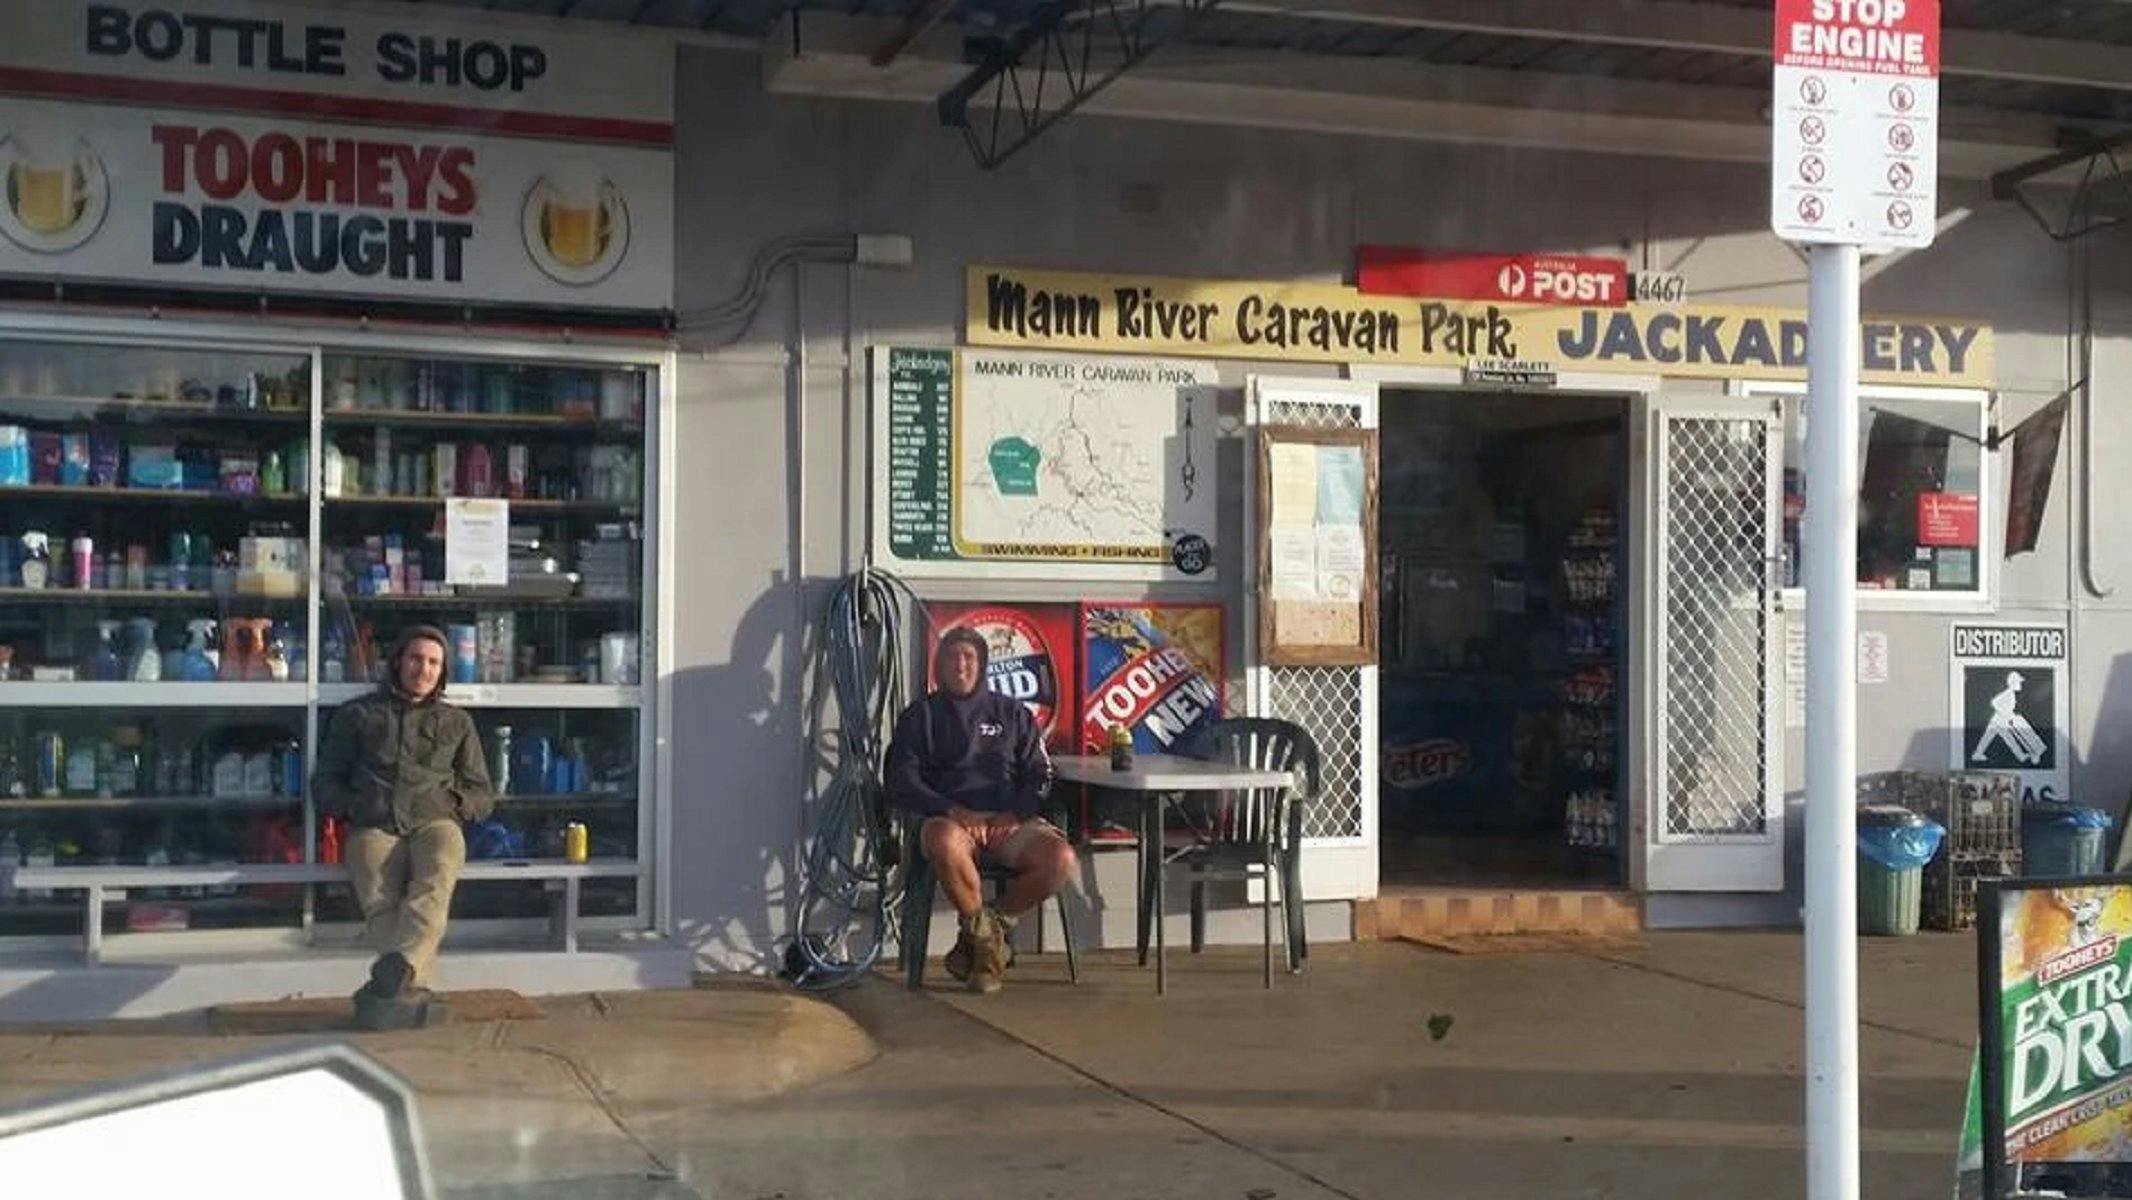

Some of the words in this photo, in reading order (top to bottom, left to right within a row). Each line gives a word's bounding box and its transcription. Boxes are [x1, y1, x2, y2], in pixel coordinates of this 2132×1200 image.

[1812, 0, 1906, 27] STOP
[86, 5, 346, 76] BOTTLE
[376, 32, 547, 91] SHOP
[1791, 22, 1925, 64] ENGINE
[152, 125, 479, 215] TOOHEYS
[152, 202, 473, 282] DRAUGHT
[1533, 272, 1615, 301] POST
[1637, 273, 1686, 302] 4467
[986, 273, 1101, 338] Mann
[1115, 287, 1219, 342] River
[1236, 295, 1399, 354] Caravan
[1420, 301, 1518, 358] Park
[1557, 309, 1979, 374] JACKADERY
[974, 361, 1023, 376] MANN
[1028, 363, 1076, 379] RIVER
[1082, 365, 1151, 382] CARAVAN
[1158, 368, 1198, 384] PARK
[981, 543, 1077, 556] SWIMMING
[1093, 545, 1160, 558] FISHING
[1956, 628, 2064, 656] DISTRIBUTOR
[1144, 675, 1216, 747] NEW
